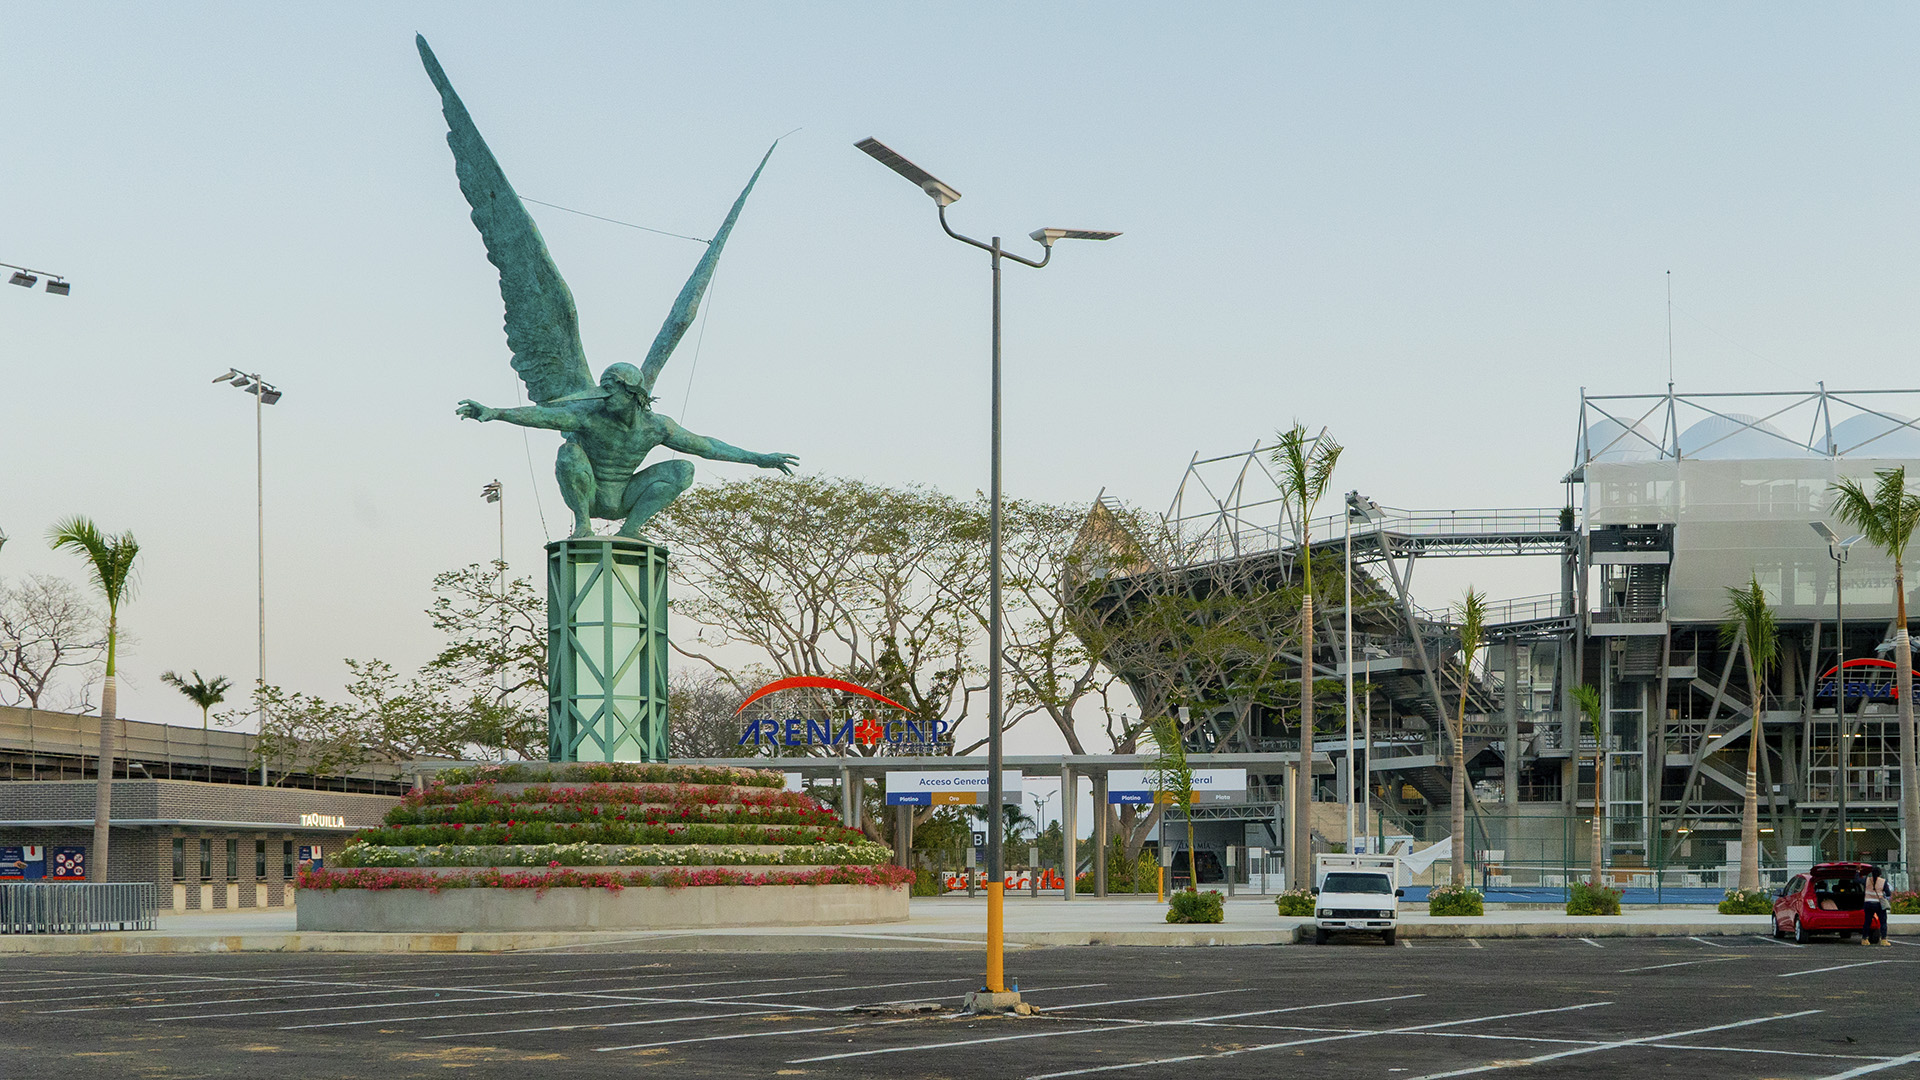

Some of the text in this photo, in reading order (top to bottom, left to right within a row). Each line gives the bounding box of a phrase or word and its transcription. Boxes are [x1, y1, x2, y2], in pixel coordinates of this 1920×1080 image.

[737, 718, 949, 746] ARENA GNP
[919, 777, 989, 786] Acceso General
[1141, 775, 1213, 785] Accso neral
[301, 812, 345, 828] TAQUILLA
[974, 834, 983, 846] B
[946, 876, 968, 890] es
